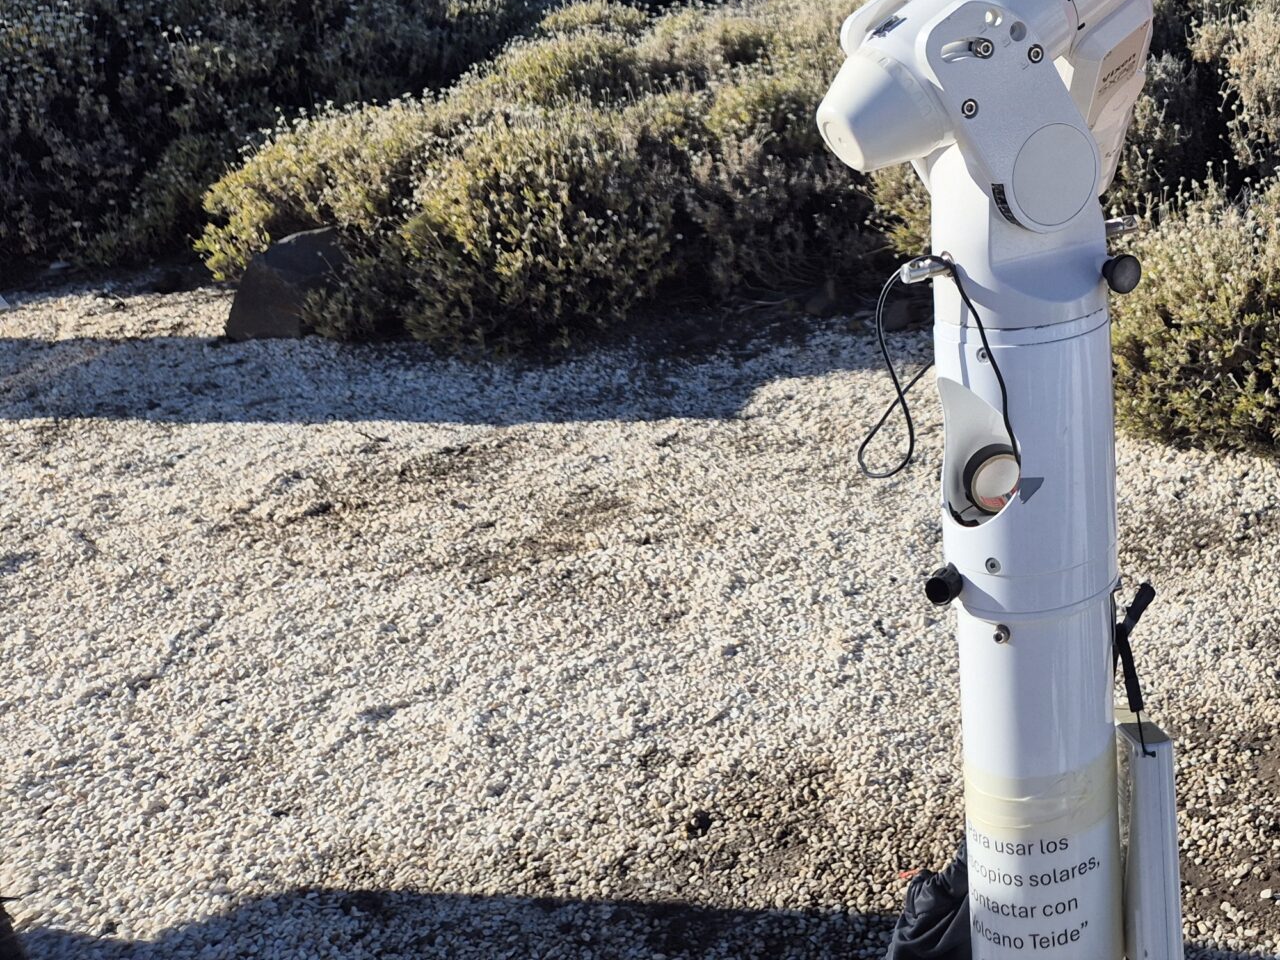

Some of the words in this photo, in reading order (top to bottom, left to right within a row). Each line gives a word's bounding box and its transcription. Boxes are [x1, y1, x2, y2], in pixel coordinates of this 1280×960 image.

[994, 839, 1034, 856] usar
[1039, 837, 1069, 855] los
[1029, 856, 1100, 887] solares,
[971, 883, 1037, 919] ontactar
[1042, 897, 1078, 917] con
